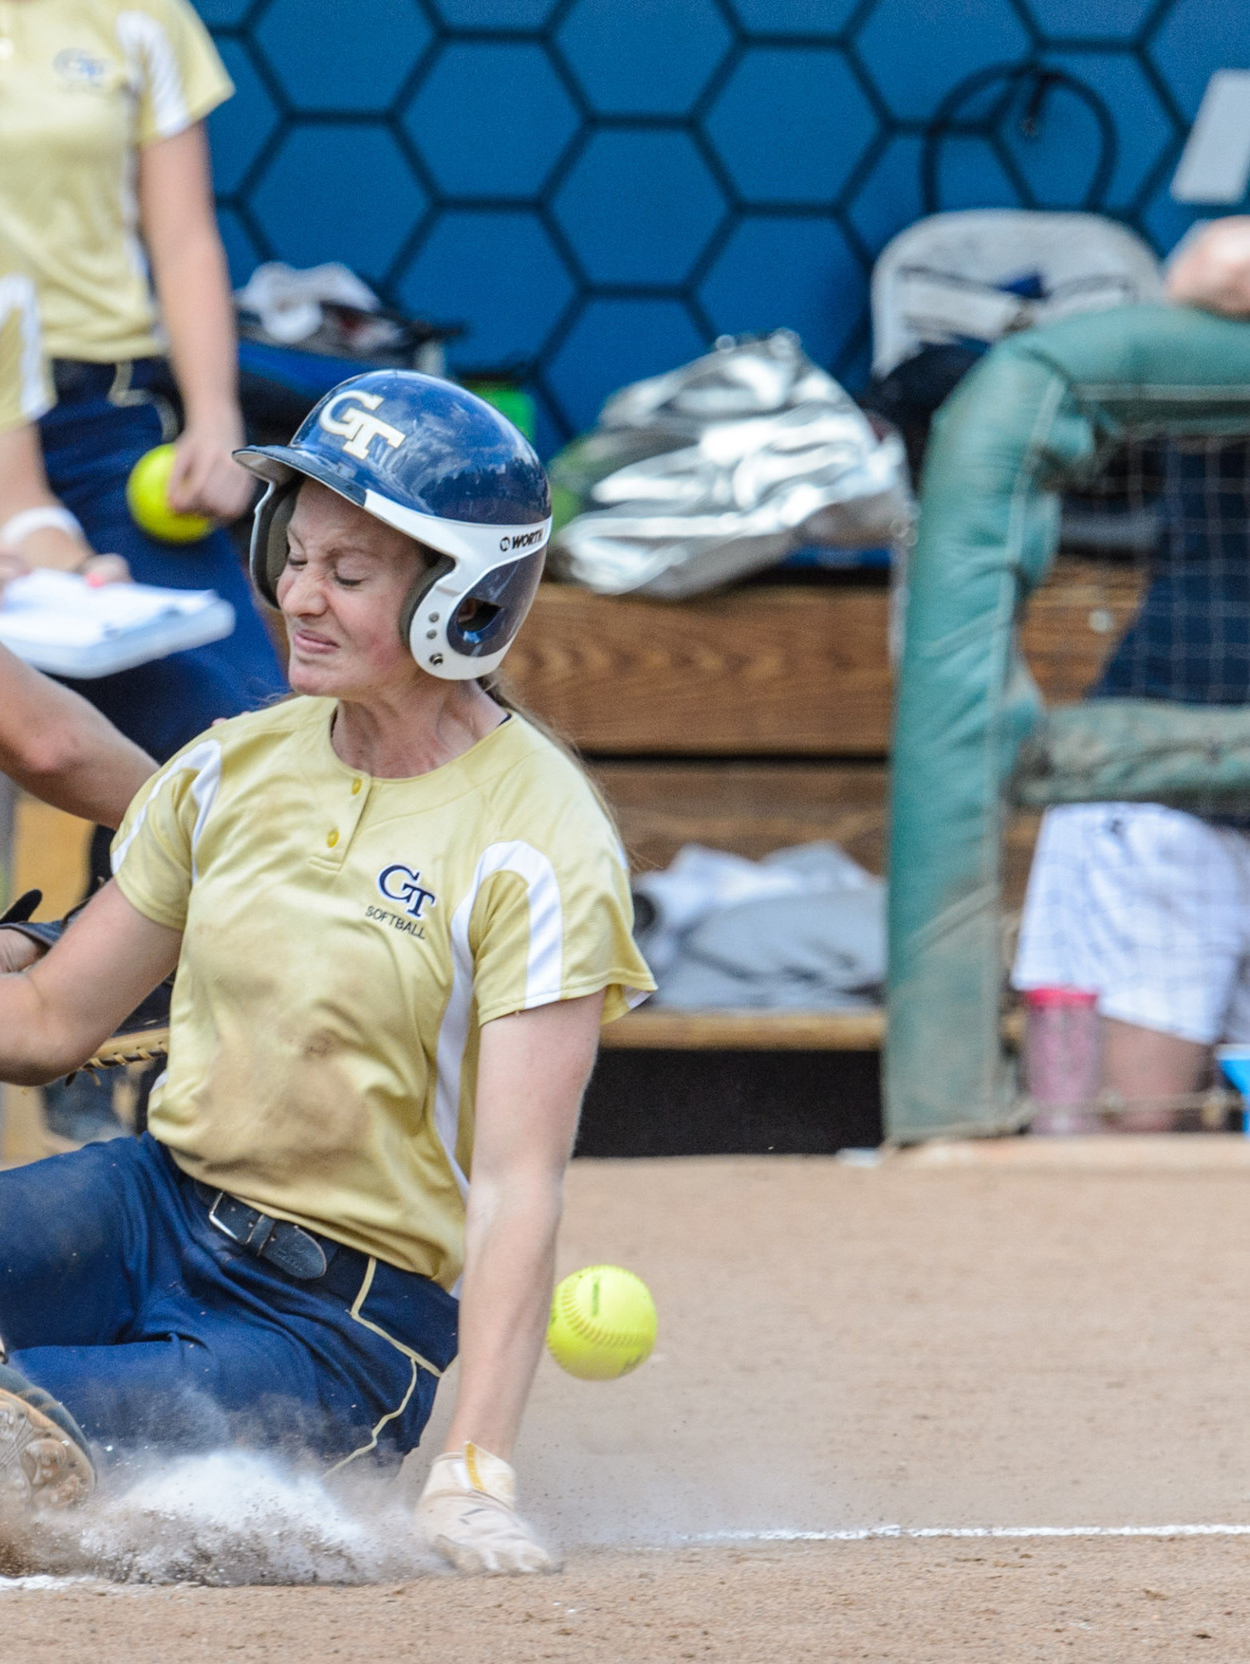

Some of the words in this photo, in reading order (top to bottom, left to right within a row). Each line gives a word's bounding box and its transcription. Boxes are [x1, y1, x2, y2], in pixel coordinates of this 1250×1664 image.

[319, 390, 406, 460] GT
[378, 864, 436, 918] GT
[365, 905, 426, 940] SOFTBALL
